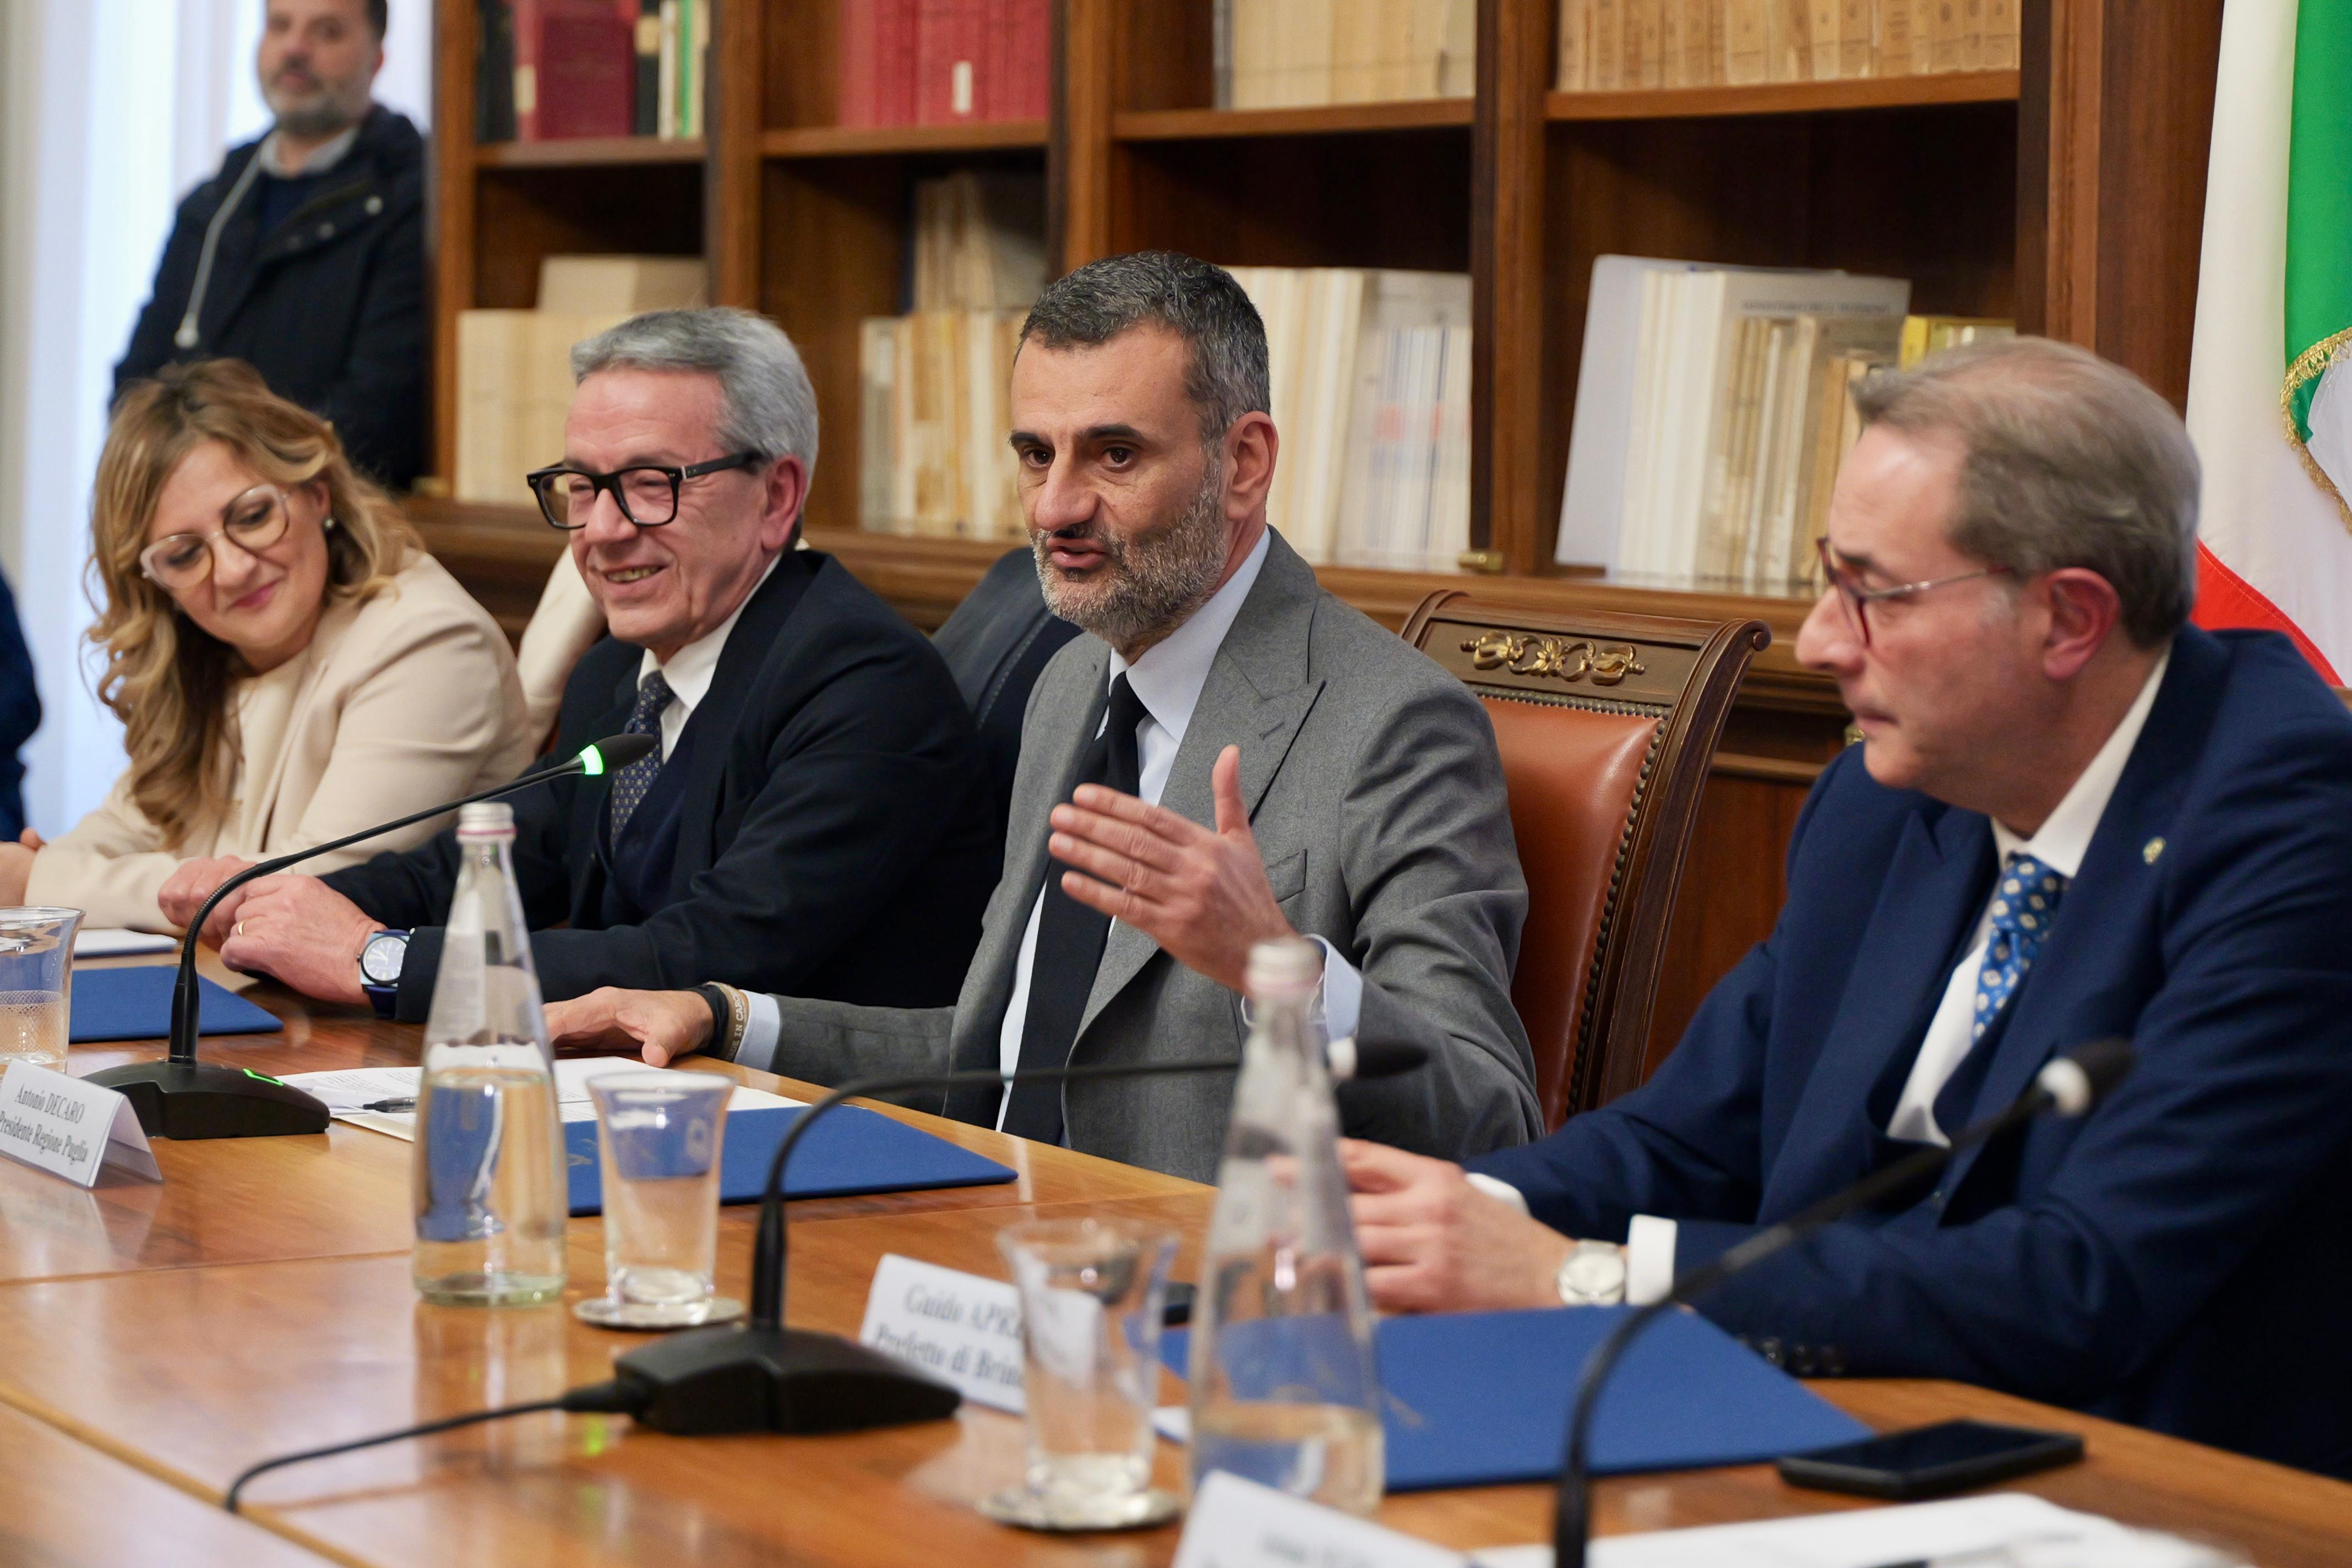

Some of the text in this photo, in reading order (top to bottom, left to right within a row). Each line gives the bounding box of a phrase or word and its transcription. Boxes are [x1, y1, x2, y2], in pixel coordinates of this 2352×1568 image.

[734, 1024, 743, 1037] IN
[15, 1084, 85, 1124] Antonio DECARO
[0, 1110, 89, 1166] Presidente Regione Puglia
[904, 1283, 963, 1321] Guido
[950, 1342, 973, 1374] di
